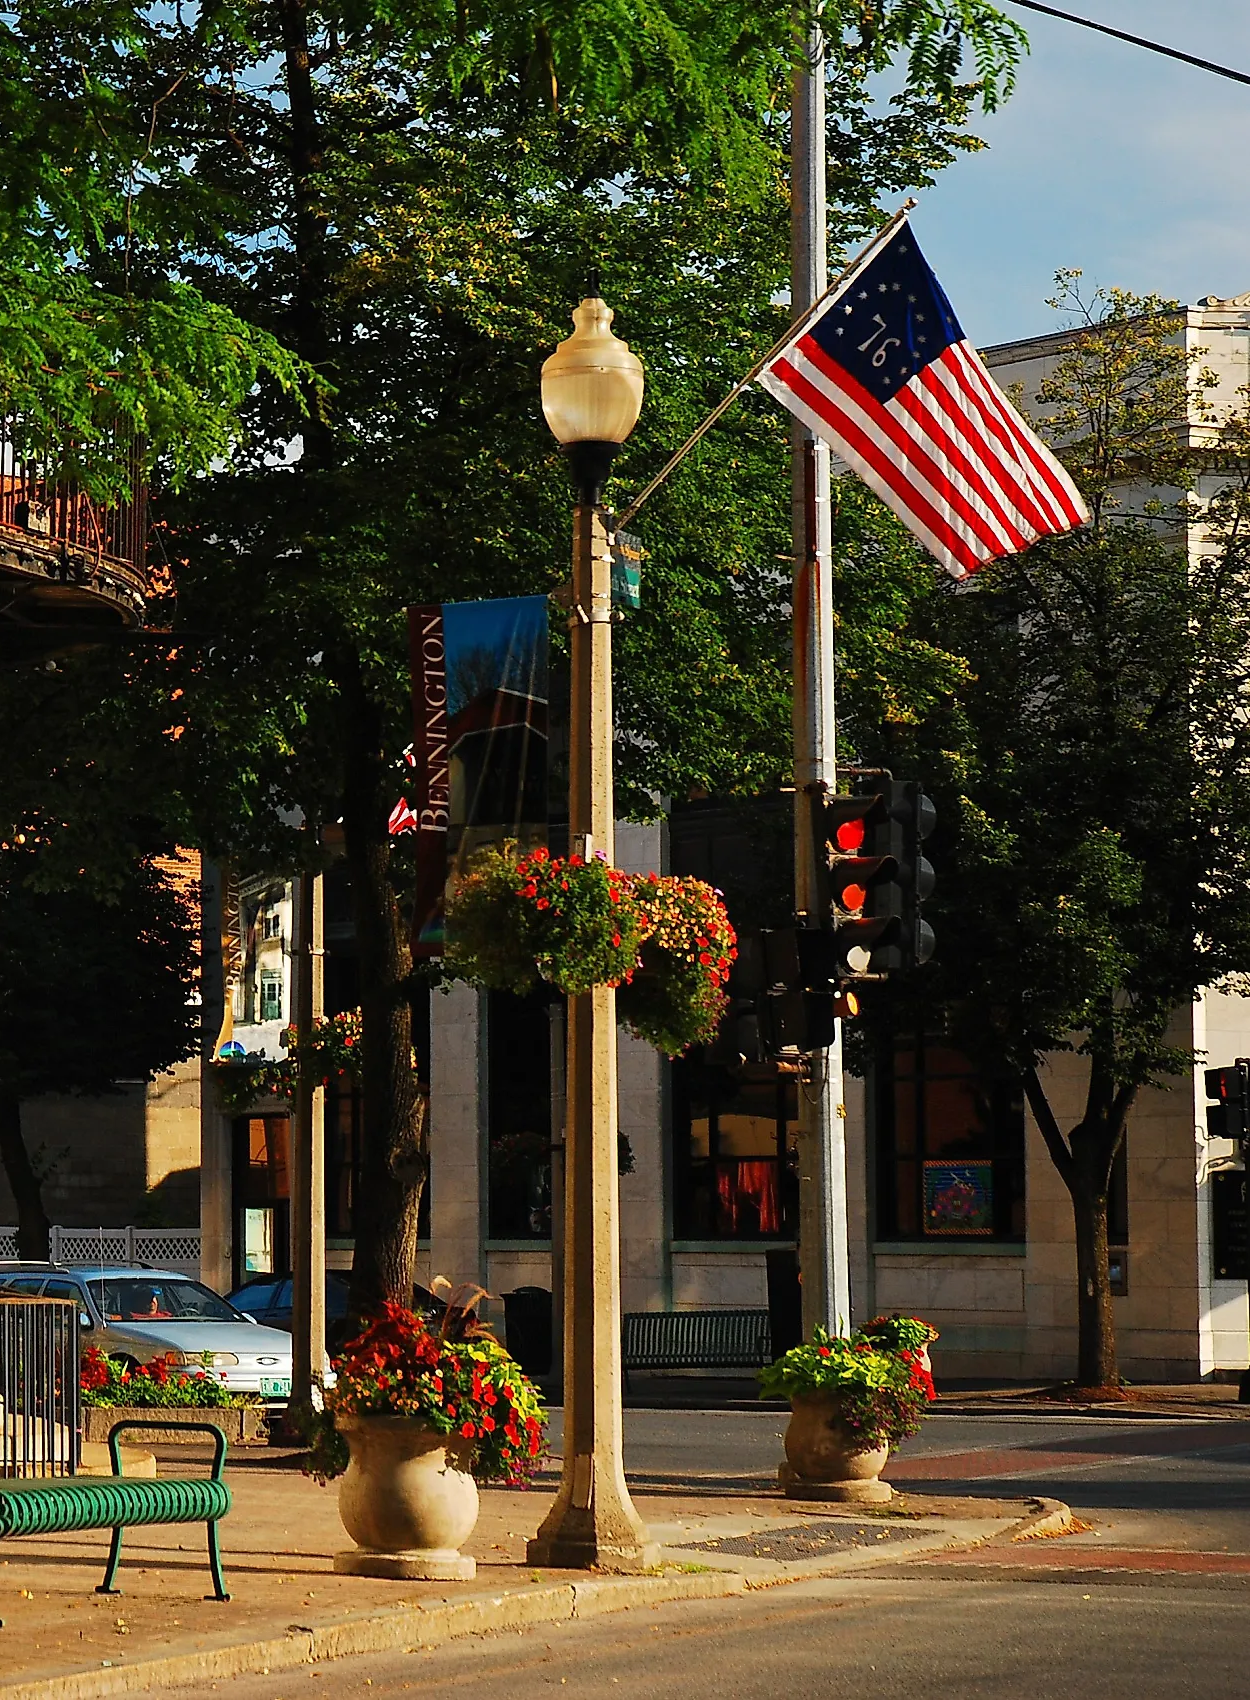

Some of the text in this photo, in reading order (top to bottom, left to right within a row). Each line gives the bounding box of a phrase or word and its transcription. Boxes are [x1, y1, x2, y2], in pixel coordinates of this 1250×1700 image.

[857, 313, 901, 367] 76
[421, 614, 450, 833] BENNINGTON
[225, 872, 242, 991] BENNINGTO
